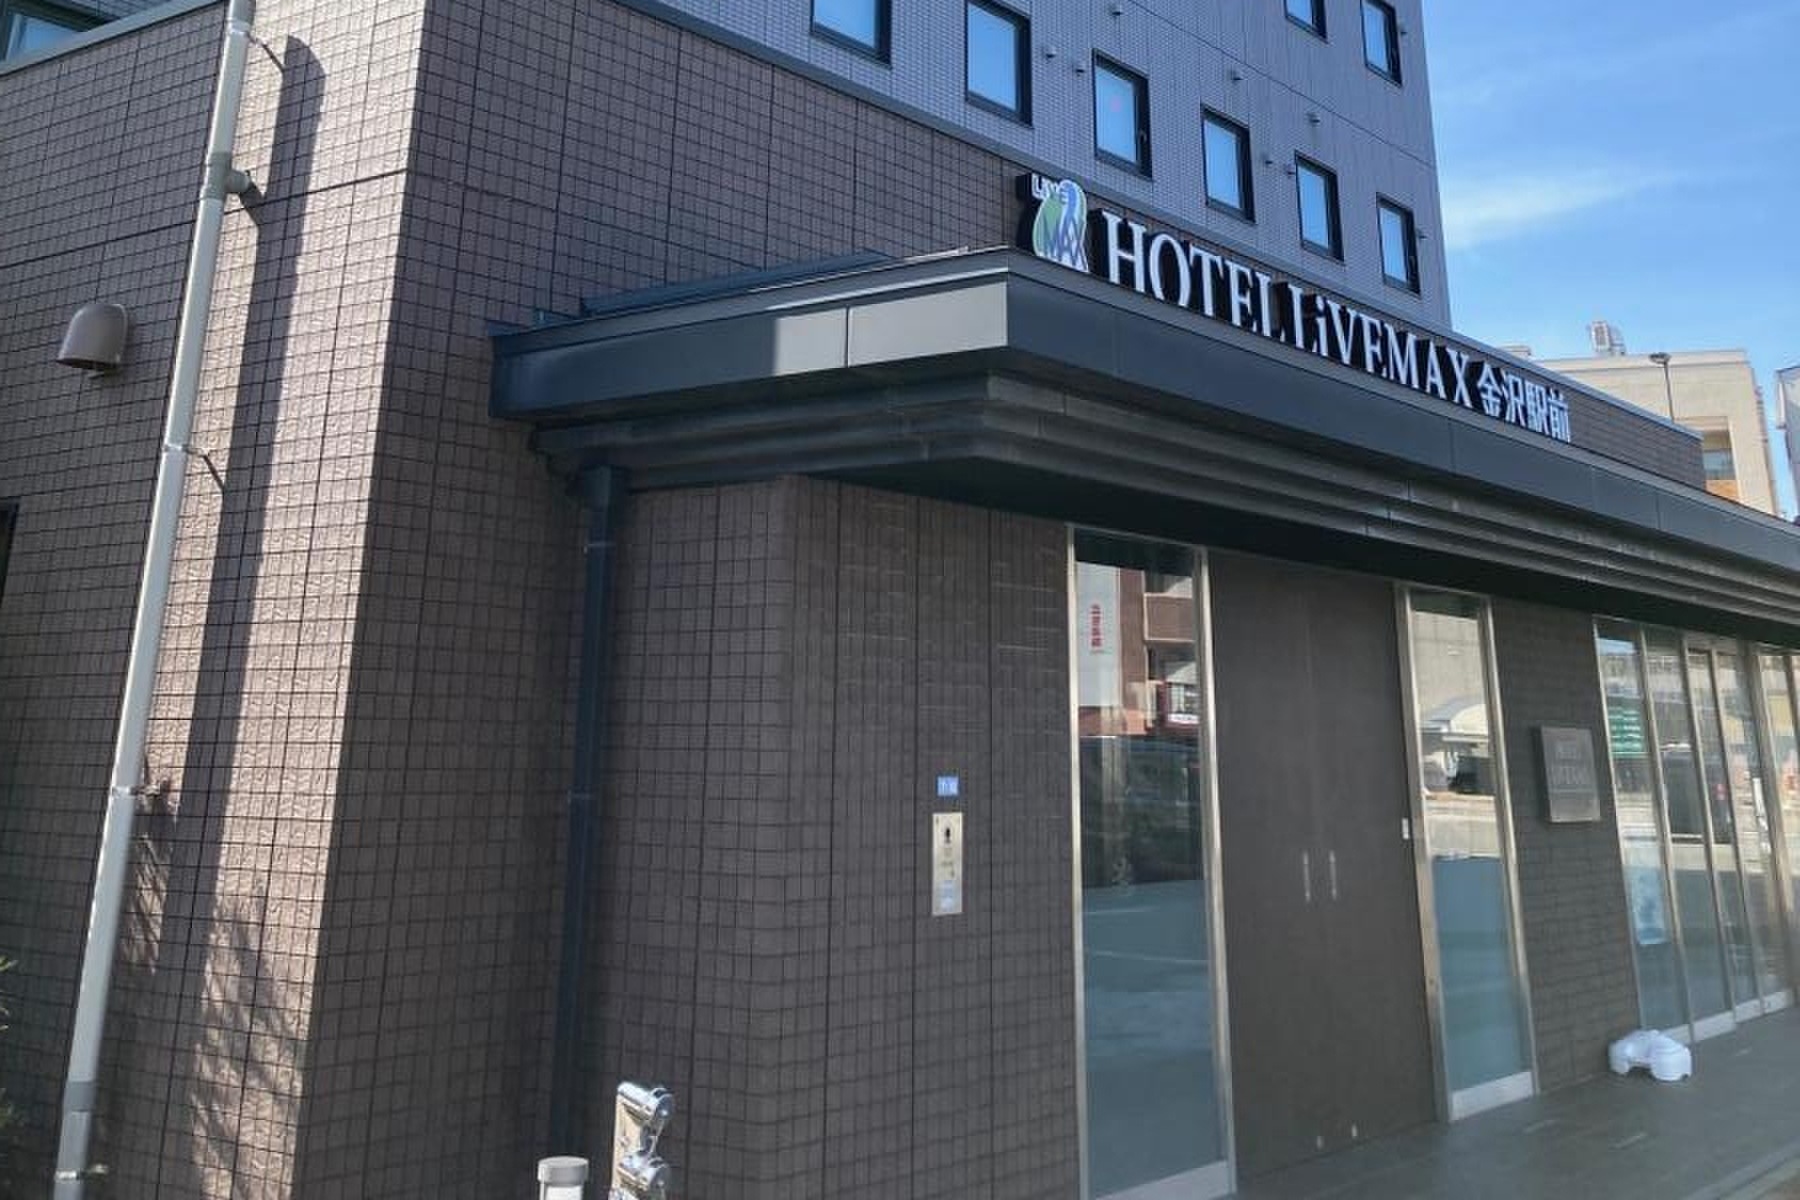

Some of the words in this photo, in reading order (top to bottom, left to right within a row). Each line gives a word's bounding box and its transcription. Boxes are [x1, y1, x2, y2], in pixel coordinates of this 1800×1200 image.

[1101, 209, 1286, 343] HOTEL
[1477, 362, 1571, 443] 金沢駅前
